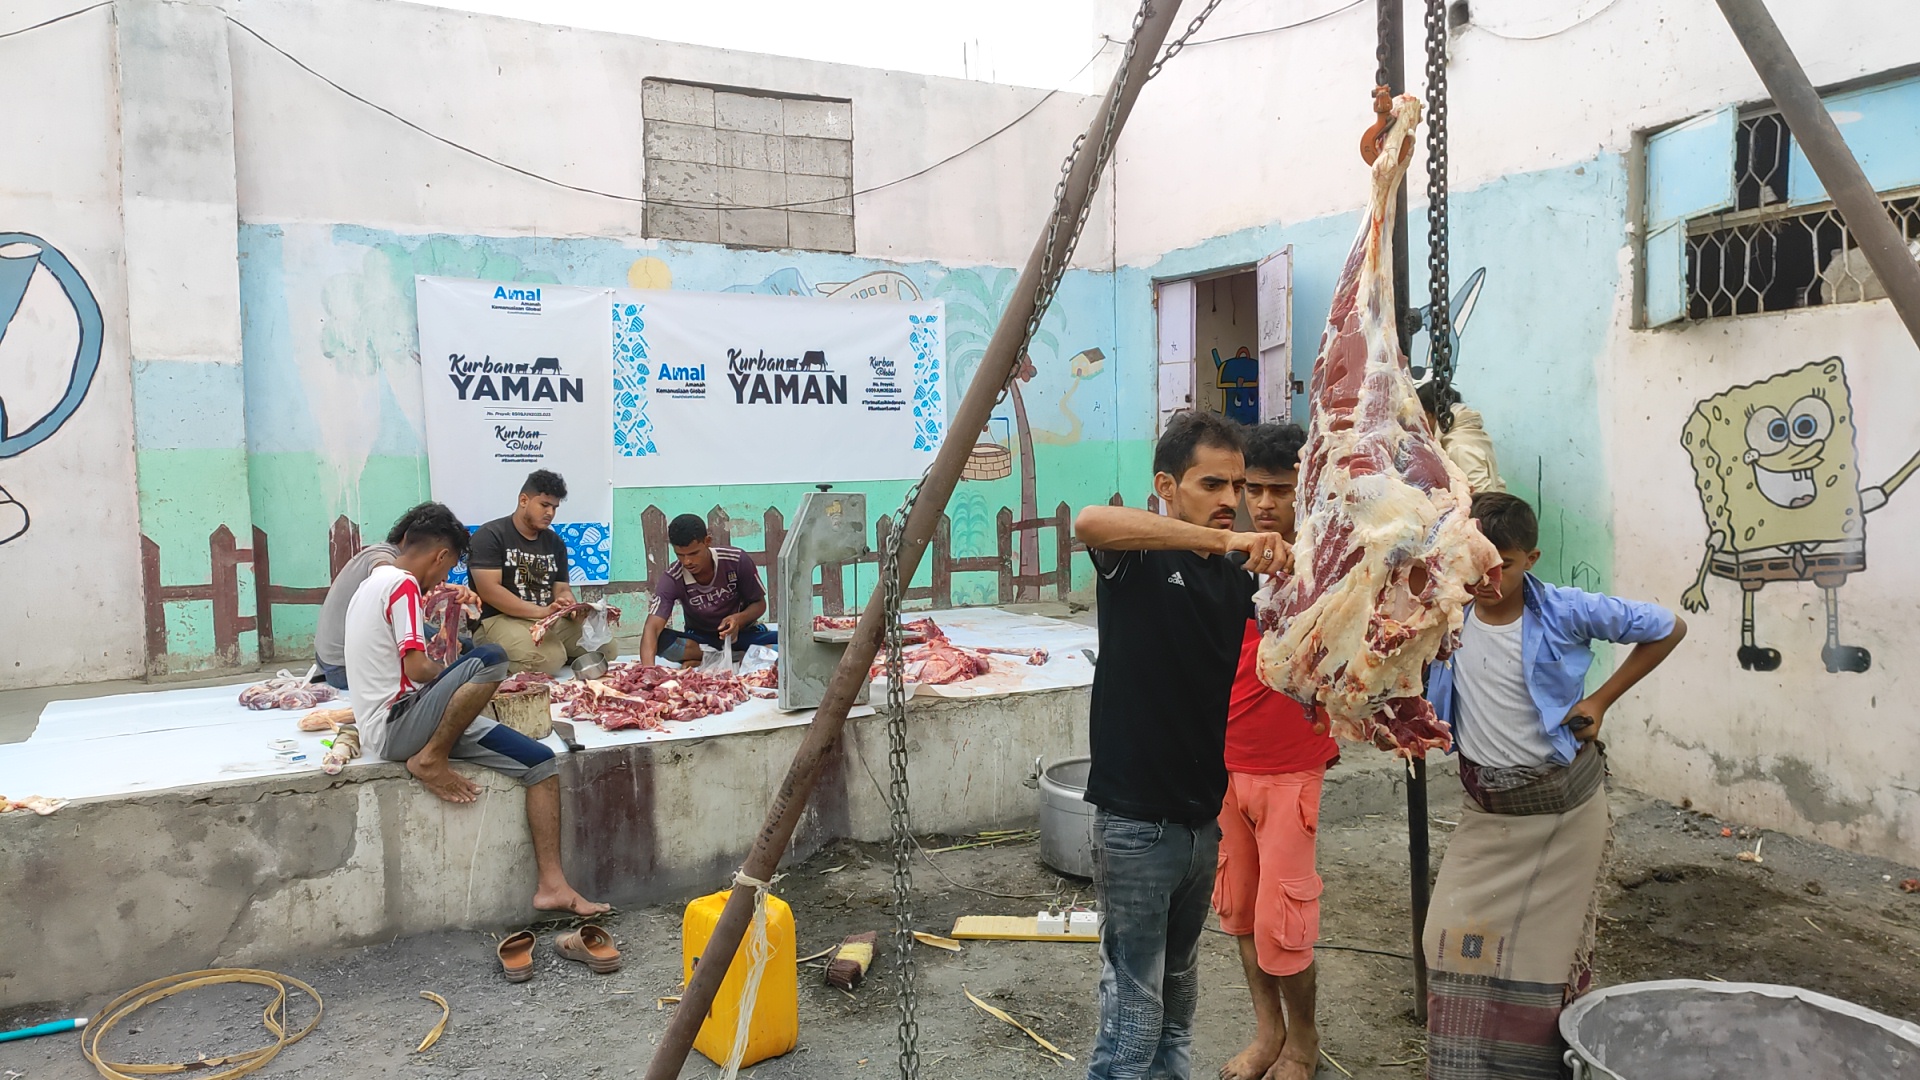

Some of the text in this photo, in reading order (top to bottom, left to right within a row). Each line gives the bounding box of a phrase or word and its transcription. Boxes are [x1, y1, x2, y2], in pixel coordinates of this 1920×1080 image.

[493, 286, 541, 301] Amal
[448, 353, 514, 376] Kurban
[658, 363, 705, 381] Amal
[727, 348, 785, 376] Kurban
[869, 356, 895, 369] Kurban
[448, 374, 584, 403] YAMAN
[727, 373, 848, 405] YAMAN
[494, 425, 541, 442] Kurban
[689, 582, 737, 606] ETIHAD
